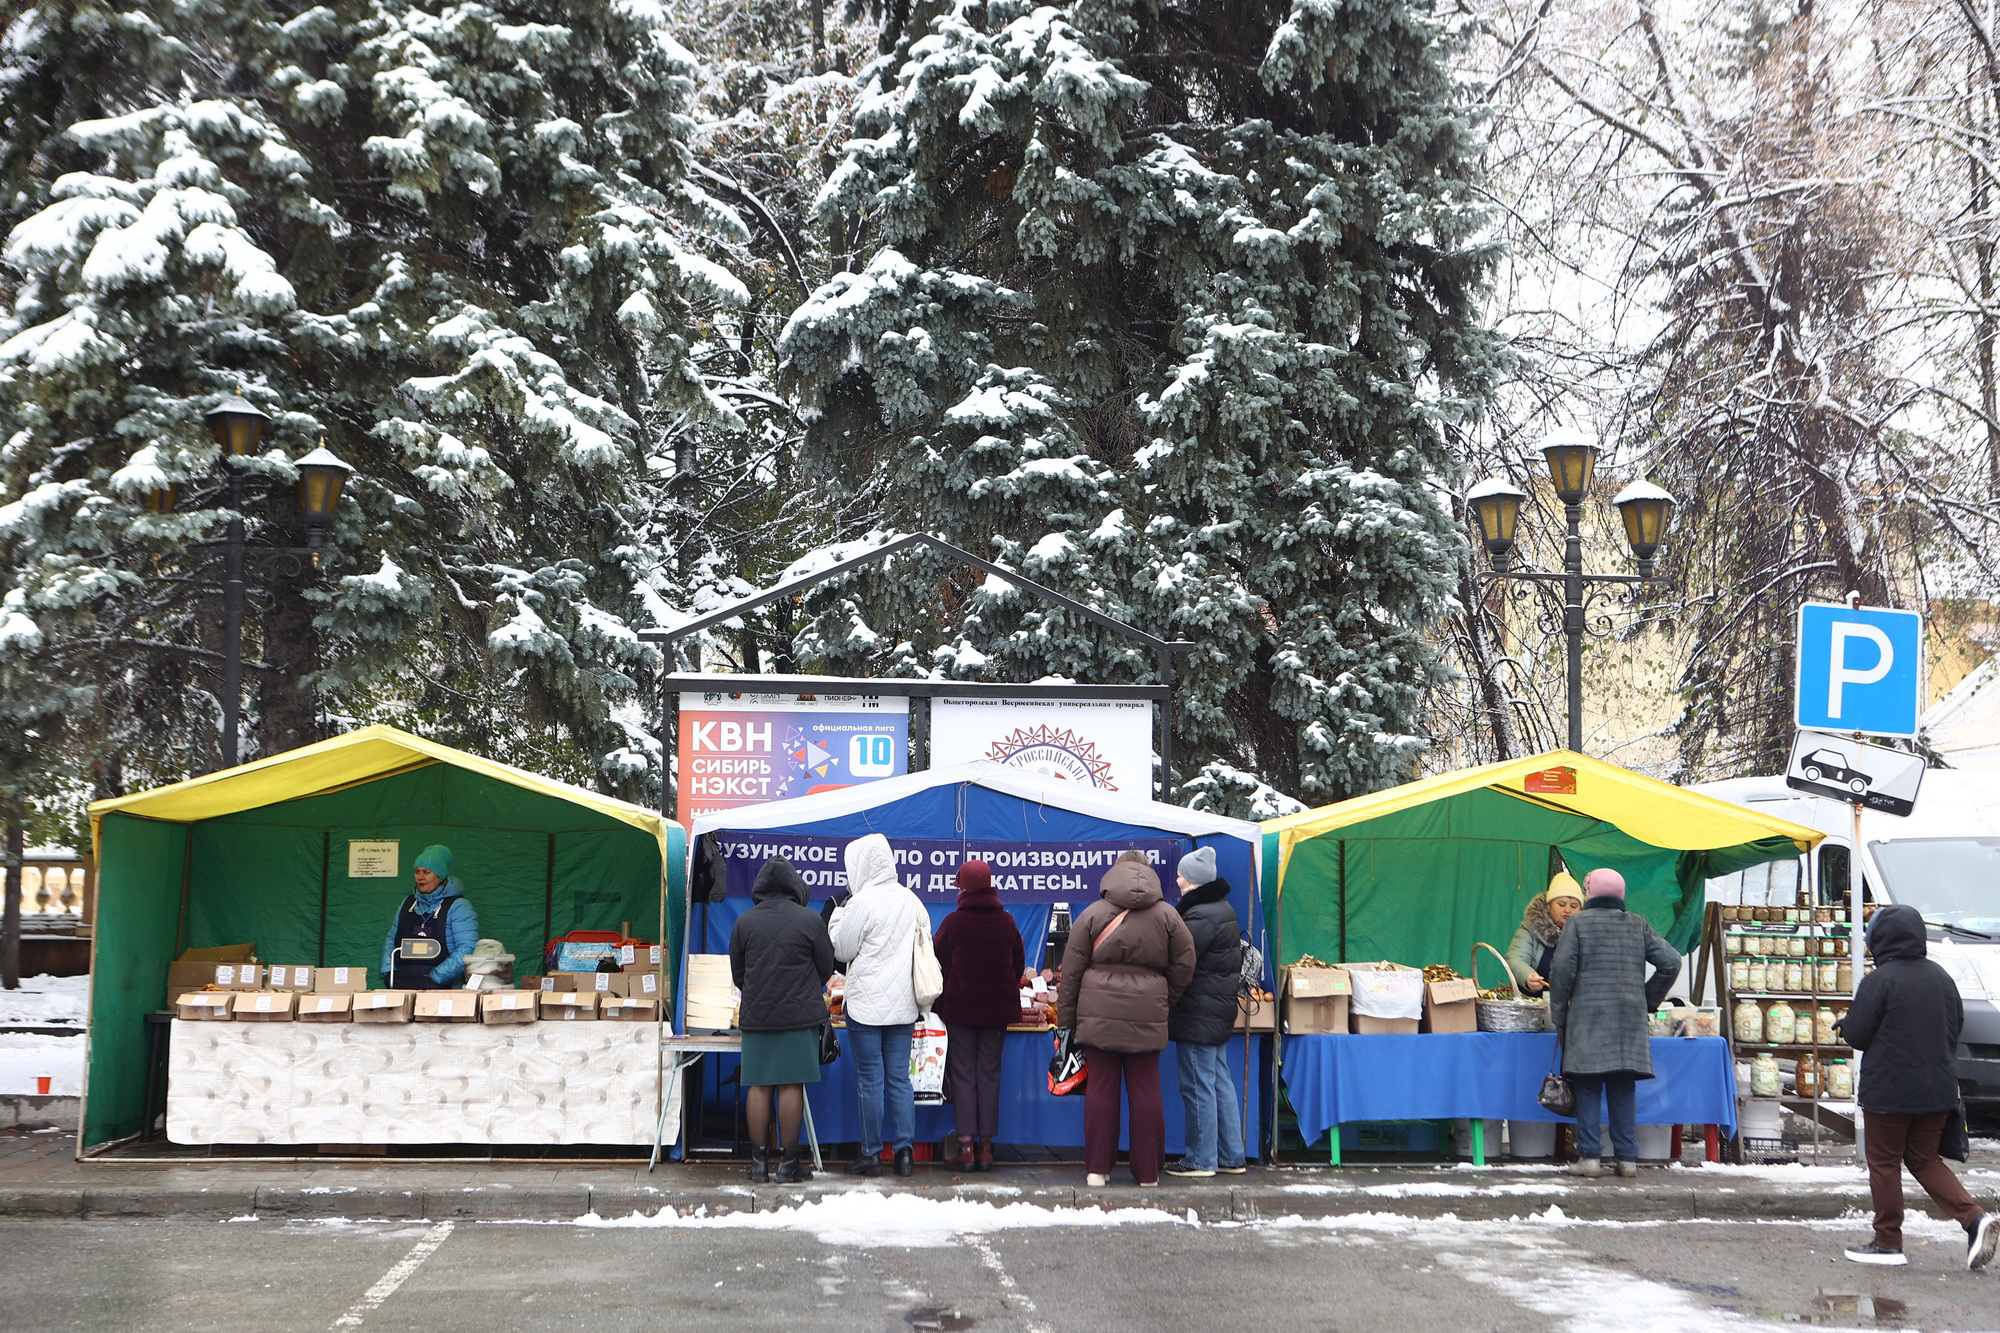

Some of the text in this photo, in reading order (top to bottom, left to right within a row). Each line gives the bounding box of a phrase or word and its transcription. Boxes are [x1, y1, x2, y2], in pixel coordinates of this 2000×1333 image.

[1827, 621, 1894, 719] P
[691, 720, 773, 752] КВН
[812, 724, 873, 733] официальная
[855, 736, 891, 765] 10
[691, 758, 773, 775] СИБИРЬ
[1009, 748, 1089, 784] ЕРОССИЙСКИЕ
[691, 777, 771, 795] НЭКСТ
[930, 850, 959, 866] ОТ
[966, 849, 1167, 869] ПРОИЗВОДИТЯ.
[906, 873, 921, 889] И
[927, 874, 1088, 892] ДЕКАТЕСЫ.
